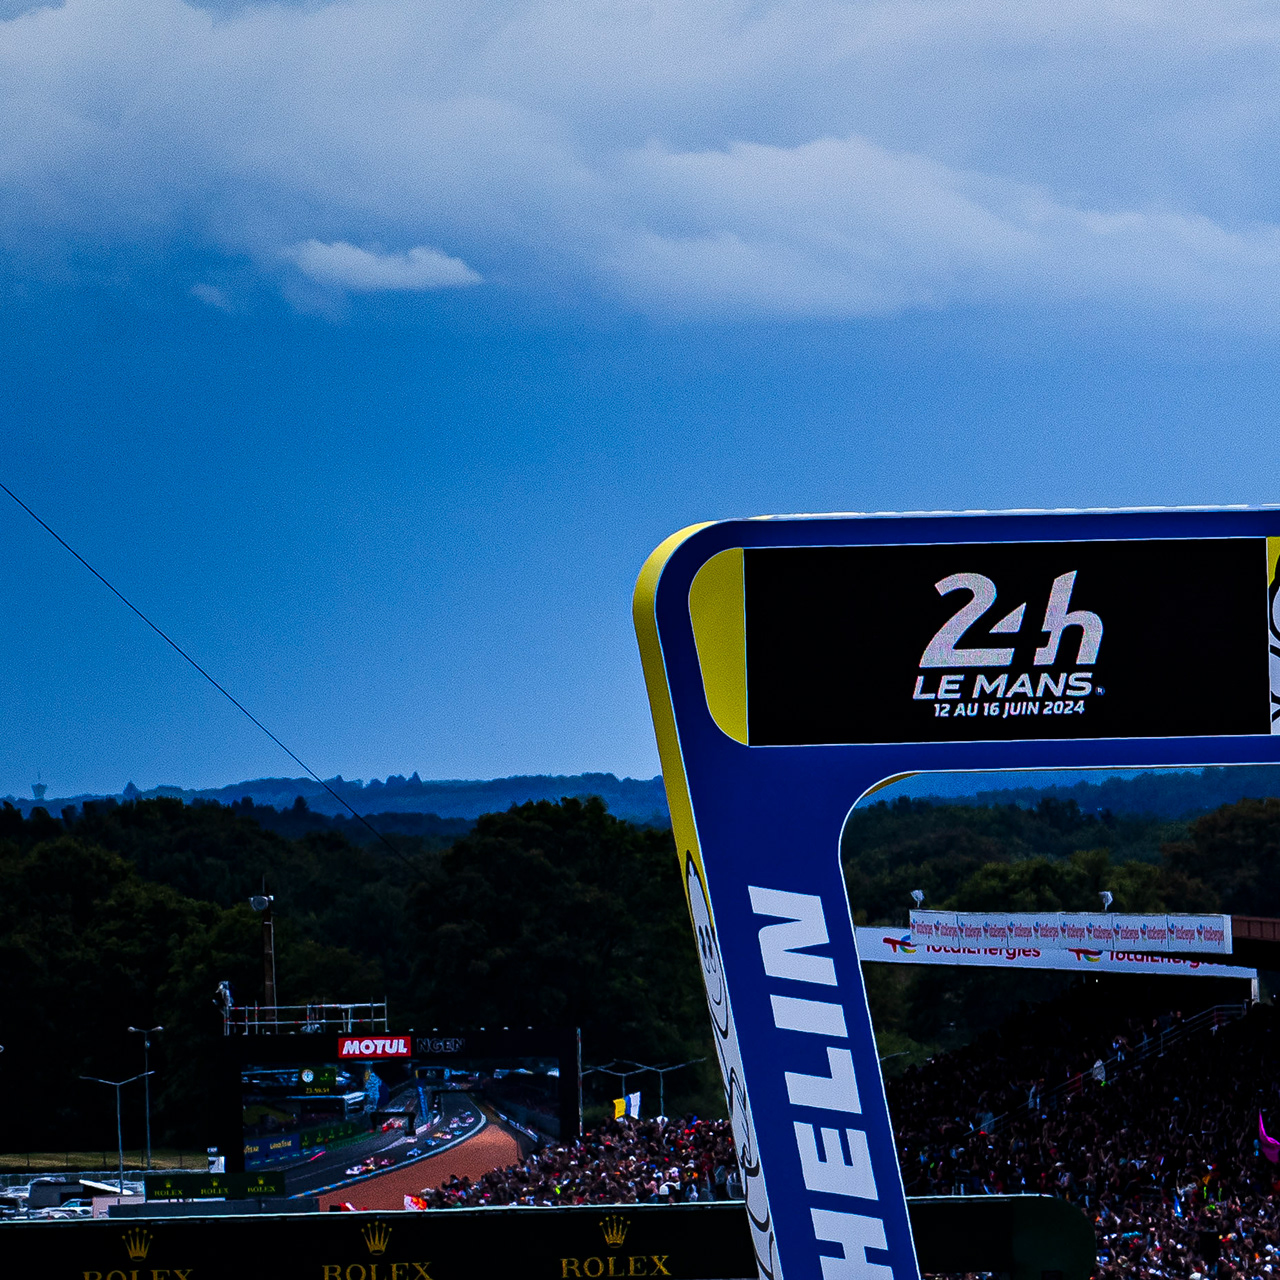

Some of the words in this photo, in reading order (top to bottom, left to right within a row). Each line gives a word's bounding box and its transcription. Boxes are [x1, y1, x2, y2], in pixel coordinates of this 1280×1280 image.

[918, 569, 1104, 668] 24h
[912, 674, 965, 700] LE
[971, 672, 1094, 699] MANS
[933, 703, 949, 717] 12
[953, 702, 979, 717] AU
[983, 702, 1000, 717] 16
[1002, 701, 1040, 719] JUIN
[1042, 700, 1085, 716] 2024
[342, 1039, 408, 1055] MOTUL
[561, 1255, 671, 1279] ROLEX
